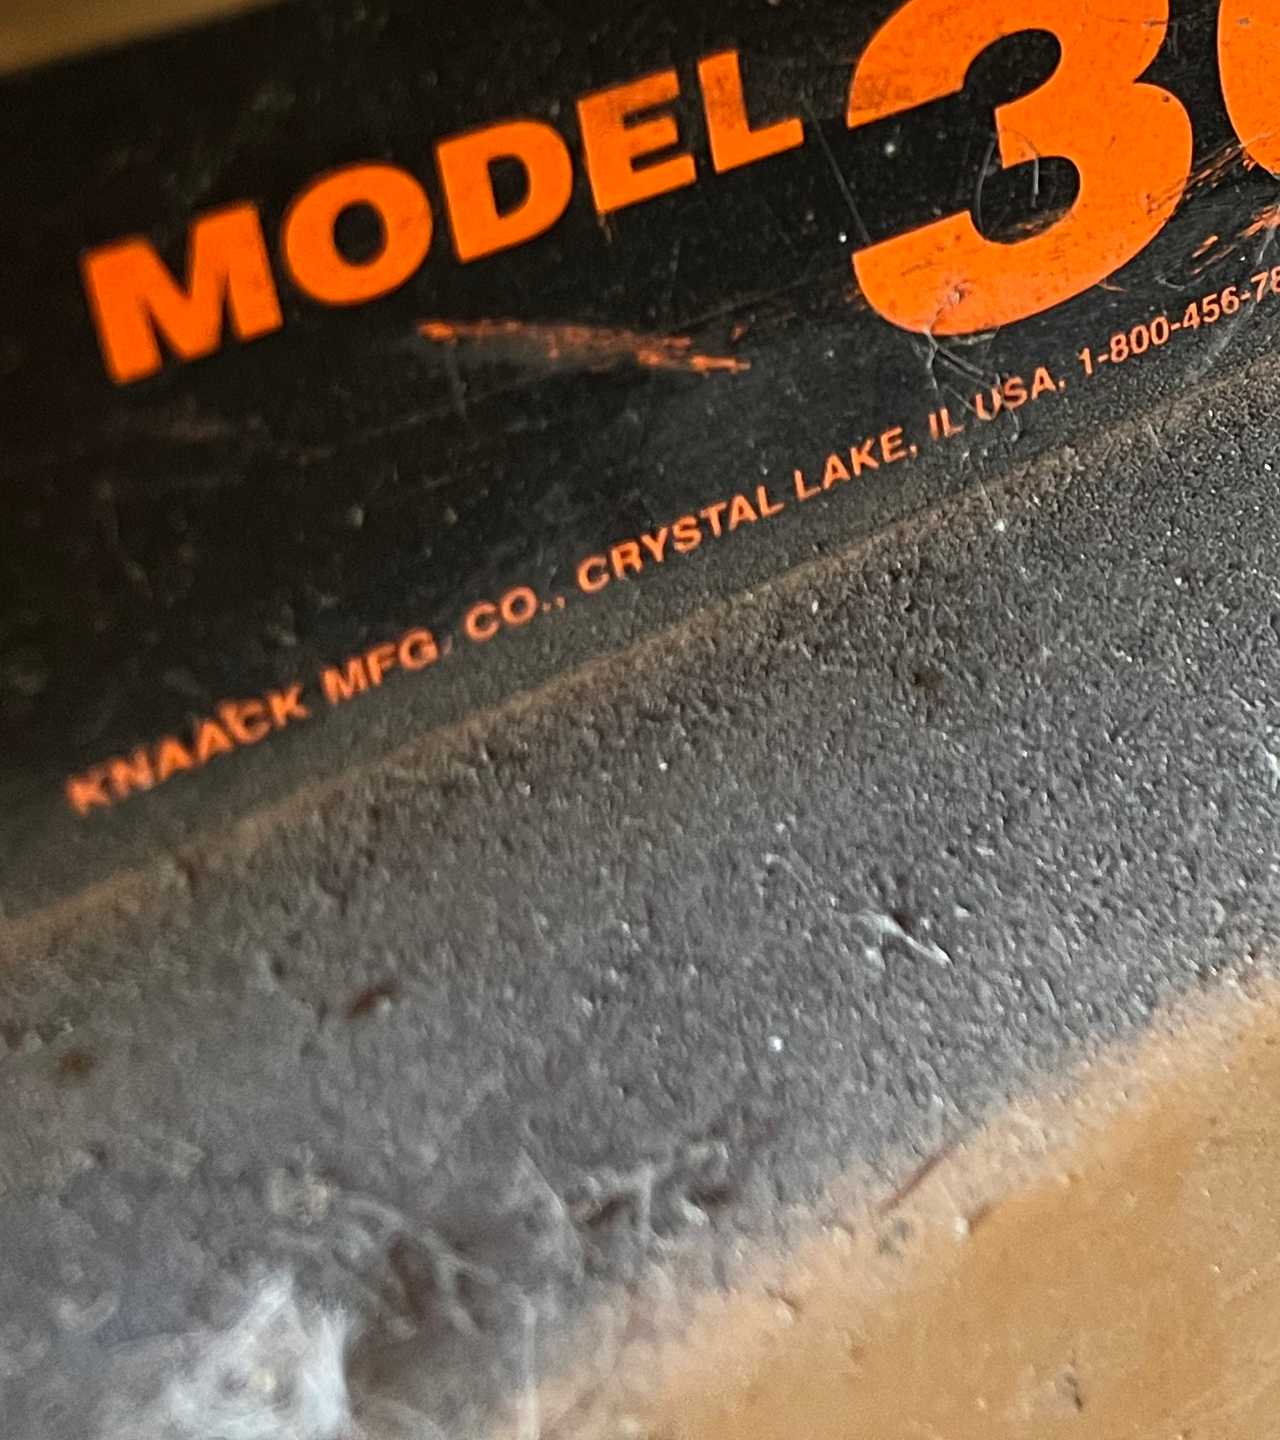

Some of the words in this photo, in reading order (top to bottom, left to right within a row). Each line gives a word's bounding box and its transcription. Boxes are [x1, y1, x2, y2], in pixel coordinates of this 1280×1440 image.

[83, 48, 805, 384] MODEL
[66, 681, 310, 816] KNAACK
[576, 483, 785, 594] CRYSTAL
[794, 425, 918, 502] LAKE,
[927, 407, 965, 441] IL
